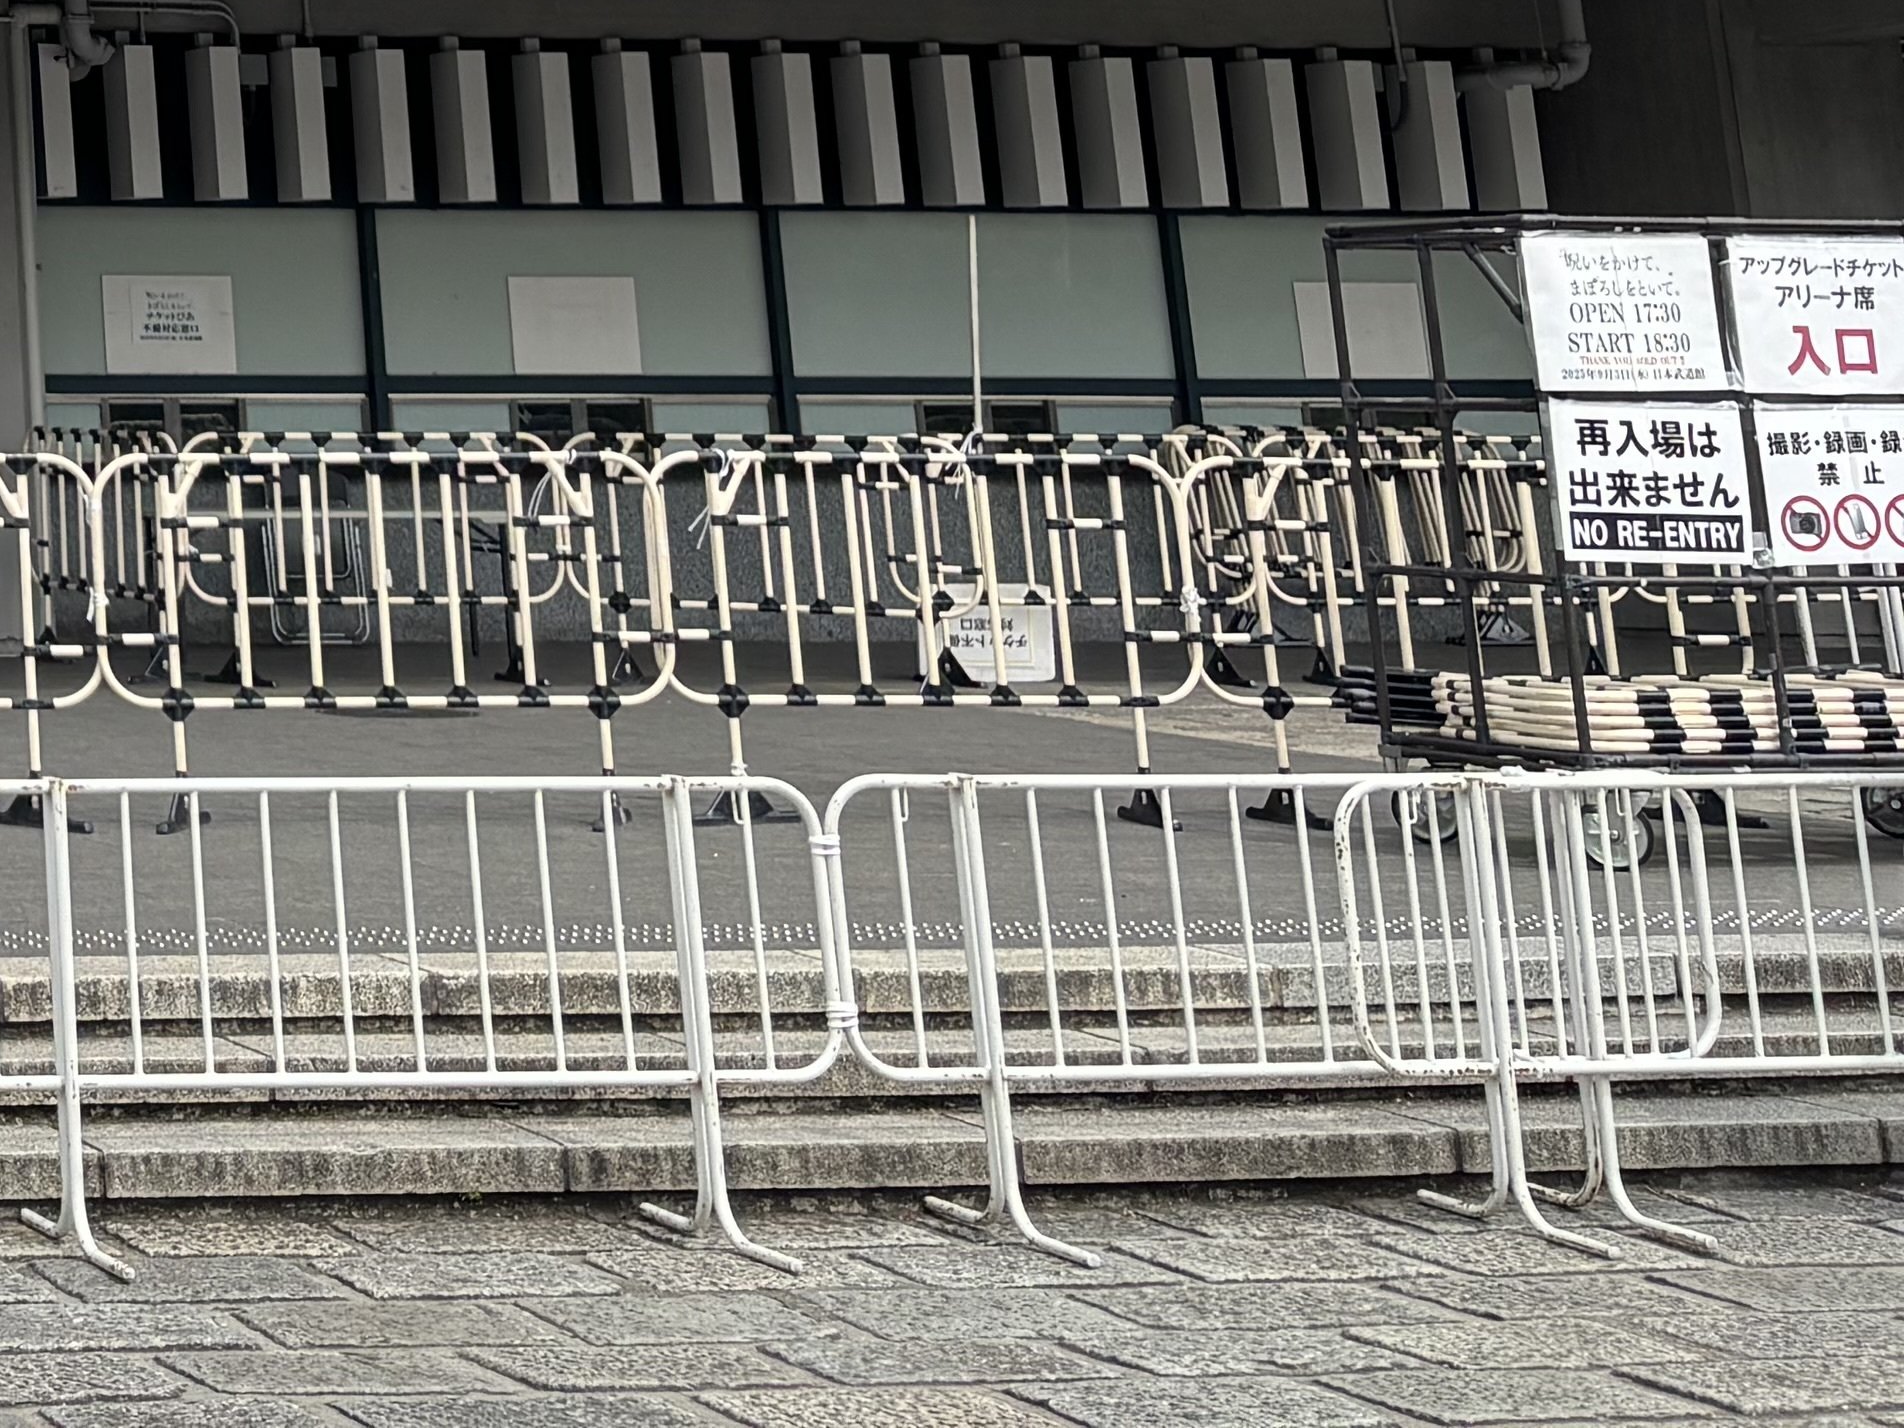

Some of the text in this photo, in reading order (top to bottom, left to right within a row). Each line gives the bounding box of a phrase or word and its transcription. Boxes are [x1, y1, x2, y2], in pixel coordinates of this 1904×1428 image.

[1774, 284, 1876, 311] アリーナ席
[1569, 302, 1682, 324] OPEN 17:30
[1567, 332, 1691, 353] START 18:30
[1787, 325, 1879, 376] 入口
[1574, 418, 1722, 458] 再入場は
[1816, 460, 1886, 486] 禁止
[1568, 467, 1740, 509] 出来ません
[1572, 518, 1741, 549] NO RE-ENTRY
